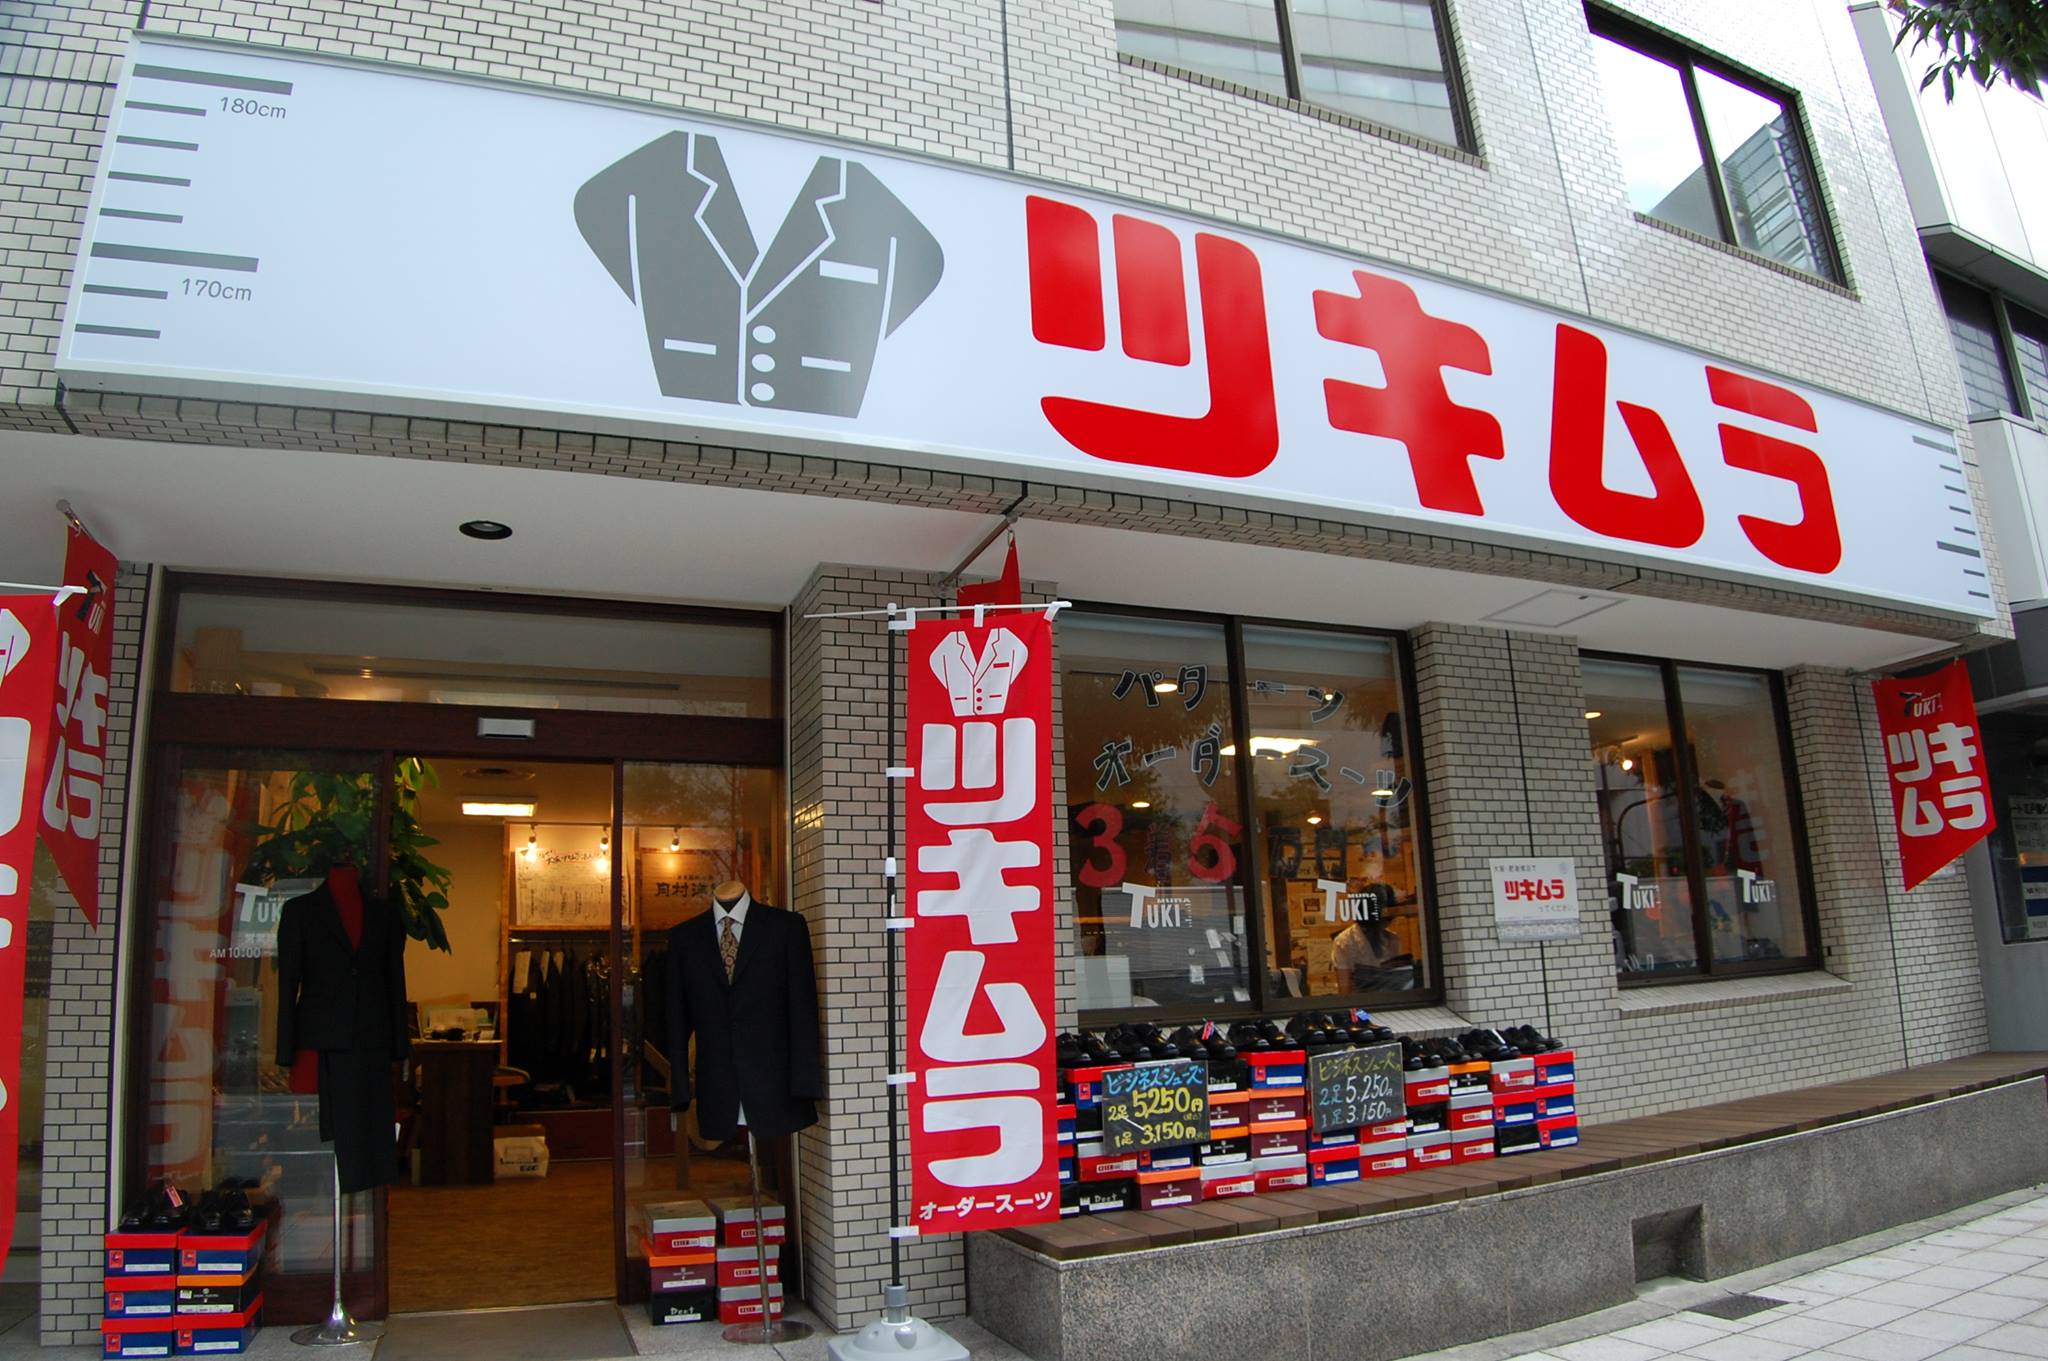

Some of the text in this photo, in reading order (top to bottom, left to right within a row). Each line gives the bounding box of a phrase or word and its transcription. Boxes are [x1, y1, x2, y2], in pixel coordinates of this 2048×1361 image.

[219, 96, 287, 119] 180cm
[181, 278, 252, 301] 170cm
[1025, 194, 1843, 575] ツキムラ
[1111, 663, 1345, 724] パターン
[1093, 722, 1412, 808] オーダースーツ
[1317, 878, 1369, 922] TUKI
[1504, 878, 1565, 901] ツキムラ
[1616, 872, 1656, 910] TUKI
[1737, 868, 1771, 903] TUKI
[1122, 881, 1181, 929] TUKI
[209, 946, 261, 959] AM 10:00
[916, 716, 1047, 1188] ツキムラ
[1106, 1065, 1204, 1095] ビジネスシューズ
[919, 1191, 1053, 1221] オーダースーツ
